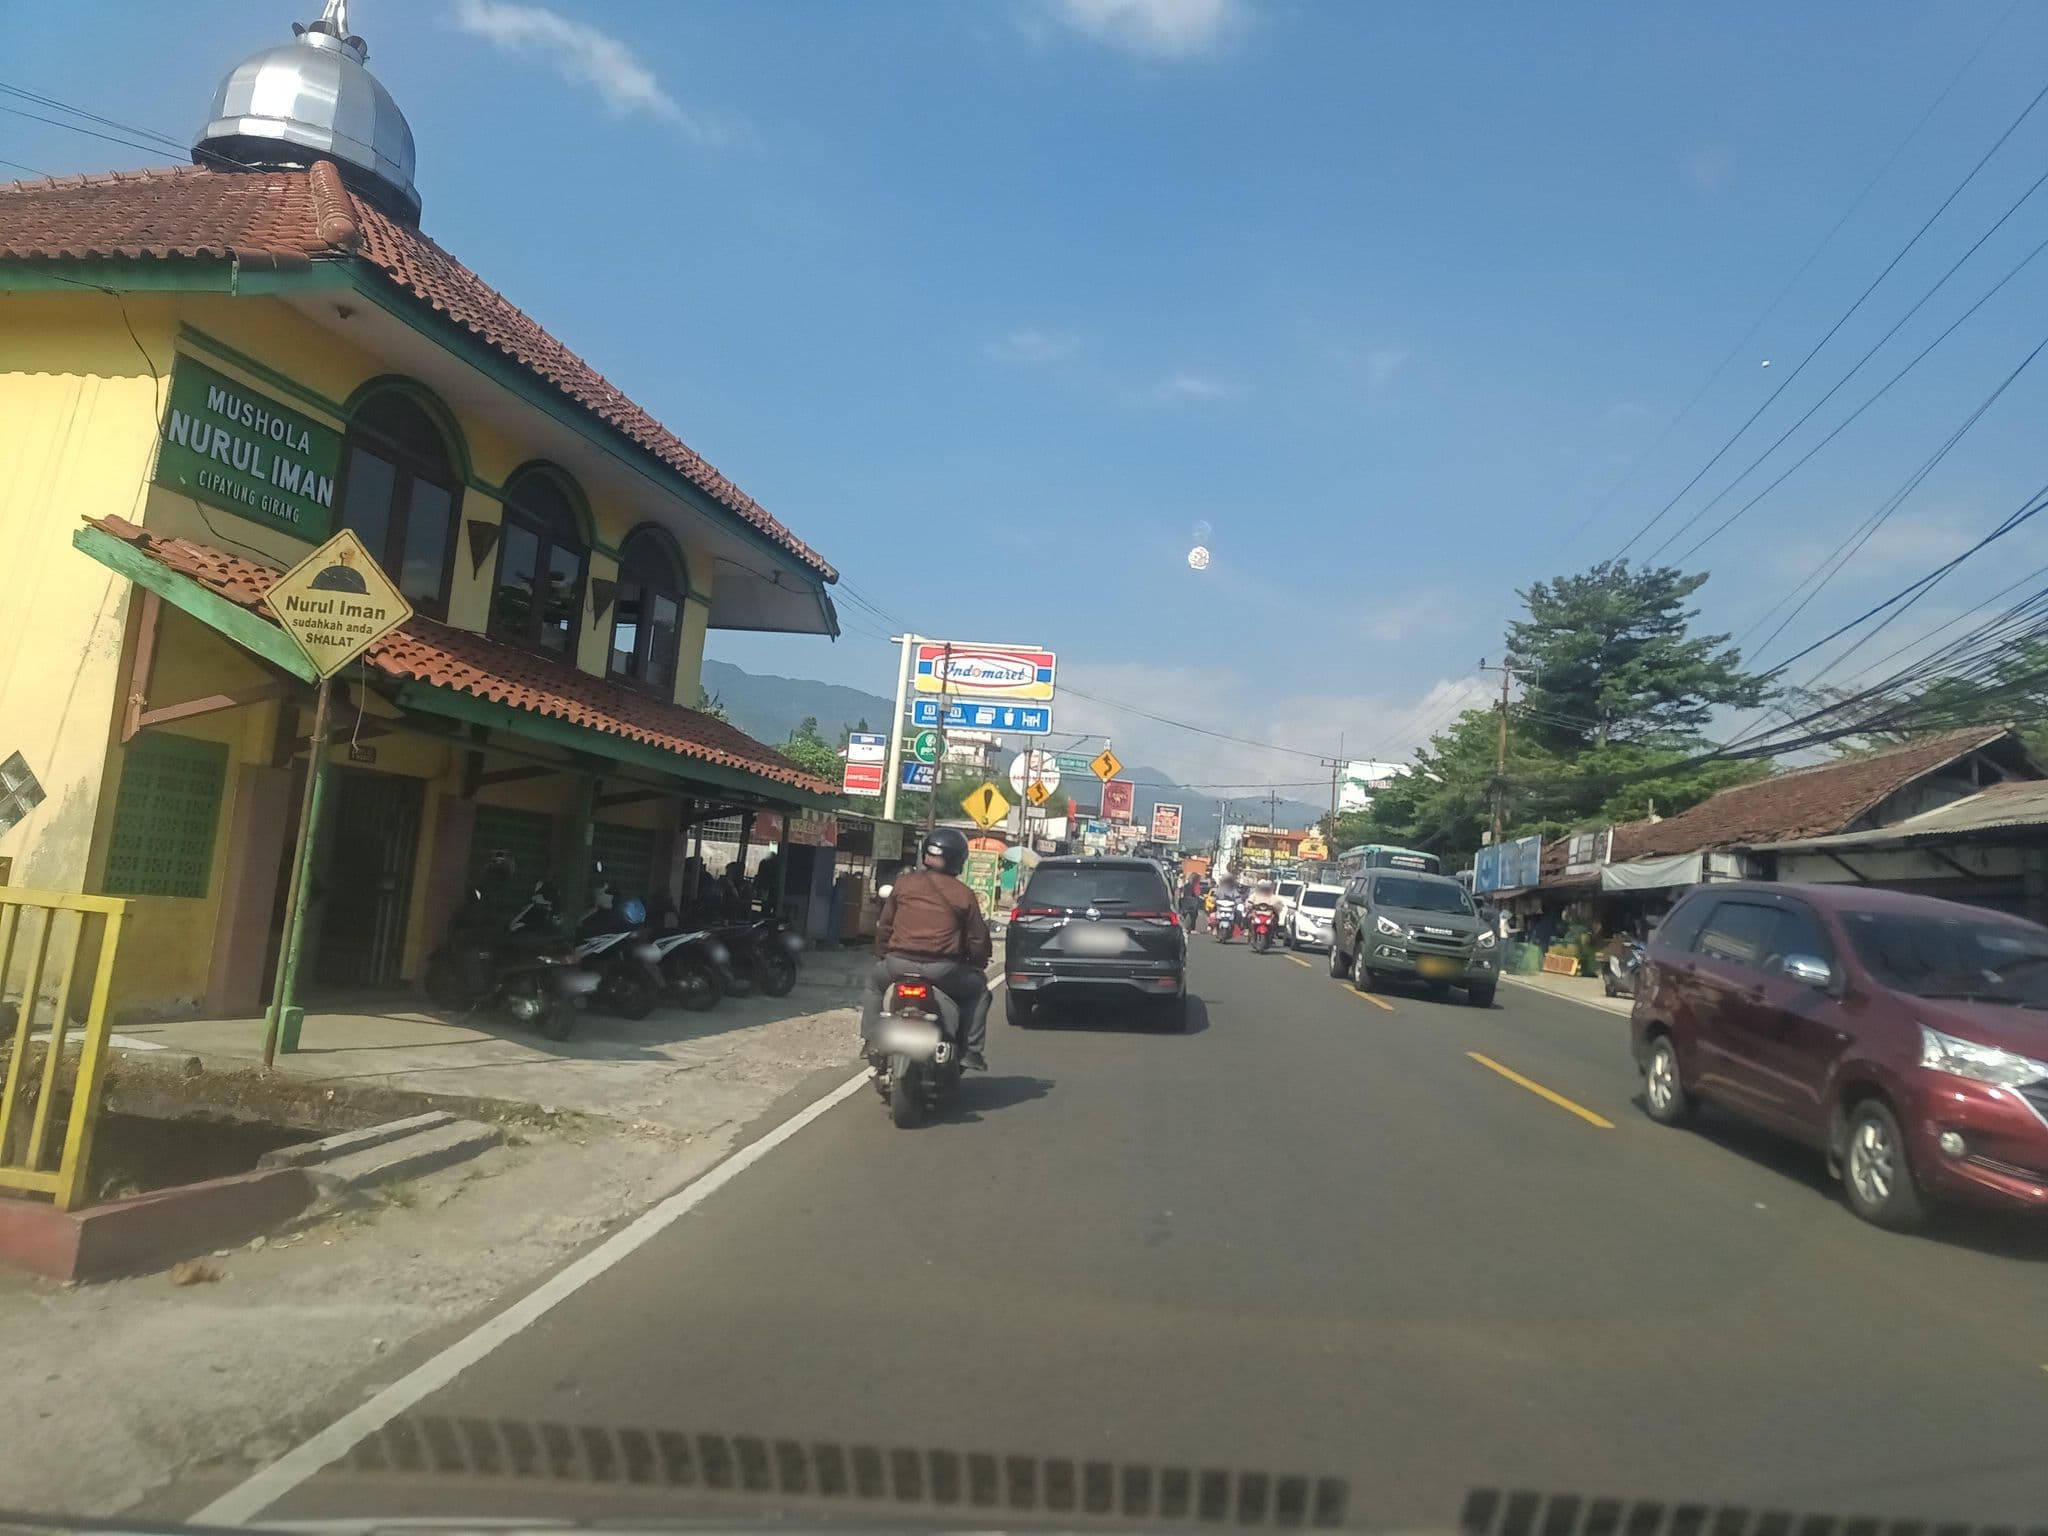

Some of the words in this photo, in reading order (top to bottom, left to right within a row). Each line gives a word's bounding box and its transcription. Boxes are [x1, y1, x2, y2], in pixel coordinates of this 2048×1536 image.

[207, 385, 311, 455] MUSHOLA
[168, 409, 265, 480] NURUL
[271, 456, 334, 508] IMAN
[199, 470, 256, 506] CIPAYUNG
[261, 494, 299, 524] GIRANG
[286, 595, 334, 615] Nurul
[340, 599, 386, 621] Iman
[292, 617, 343, 632] sudahkah
[346, 623, 373, 635] anda
[305, 632, 354, 648] SHALAT
